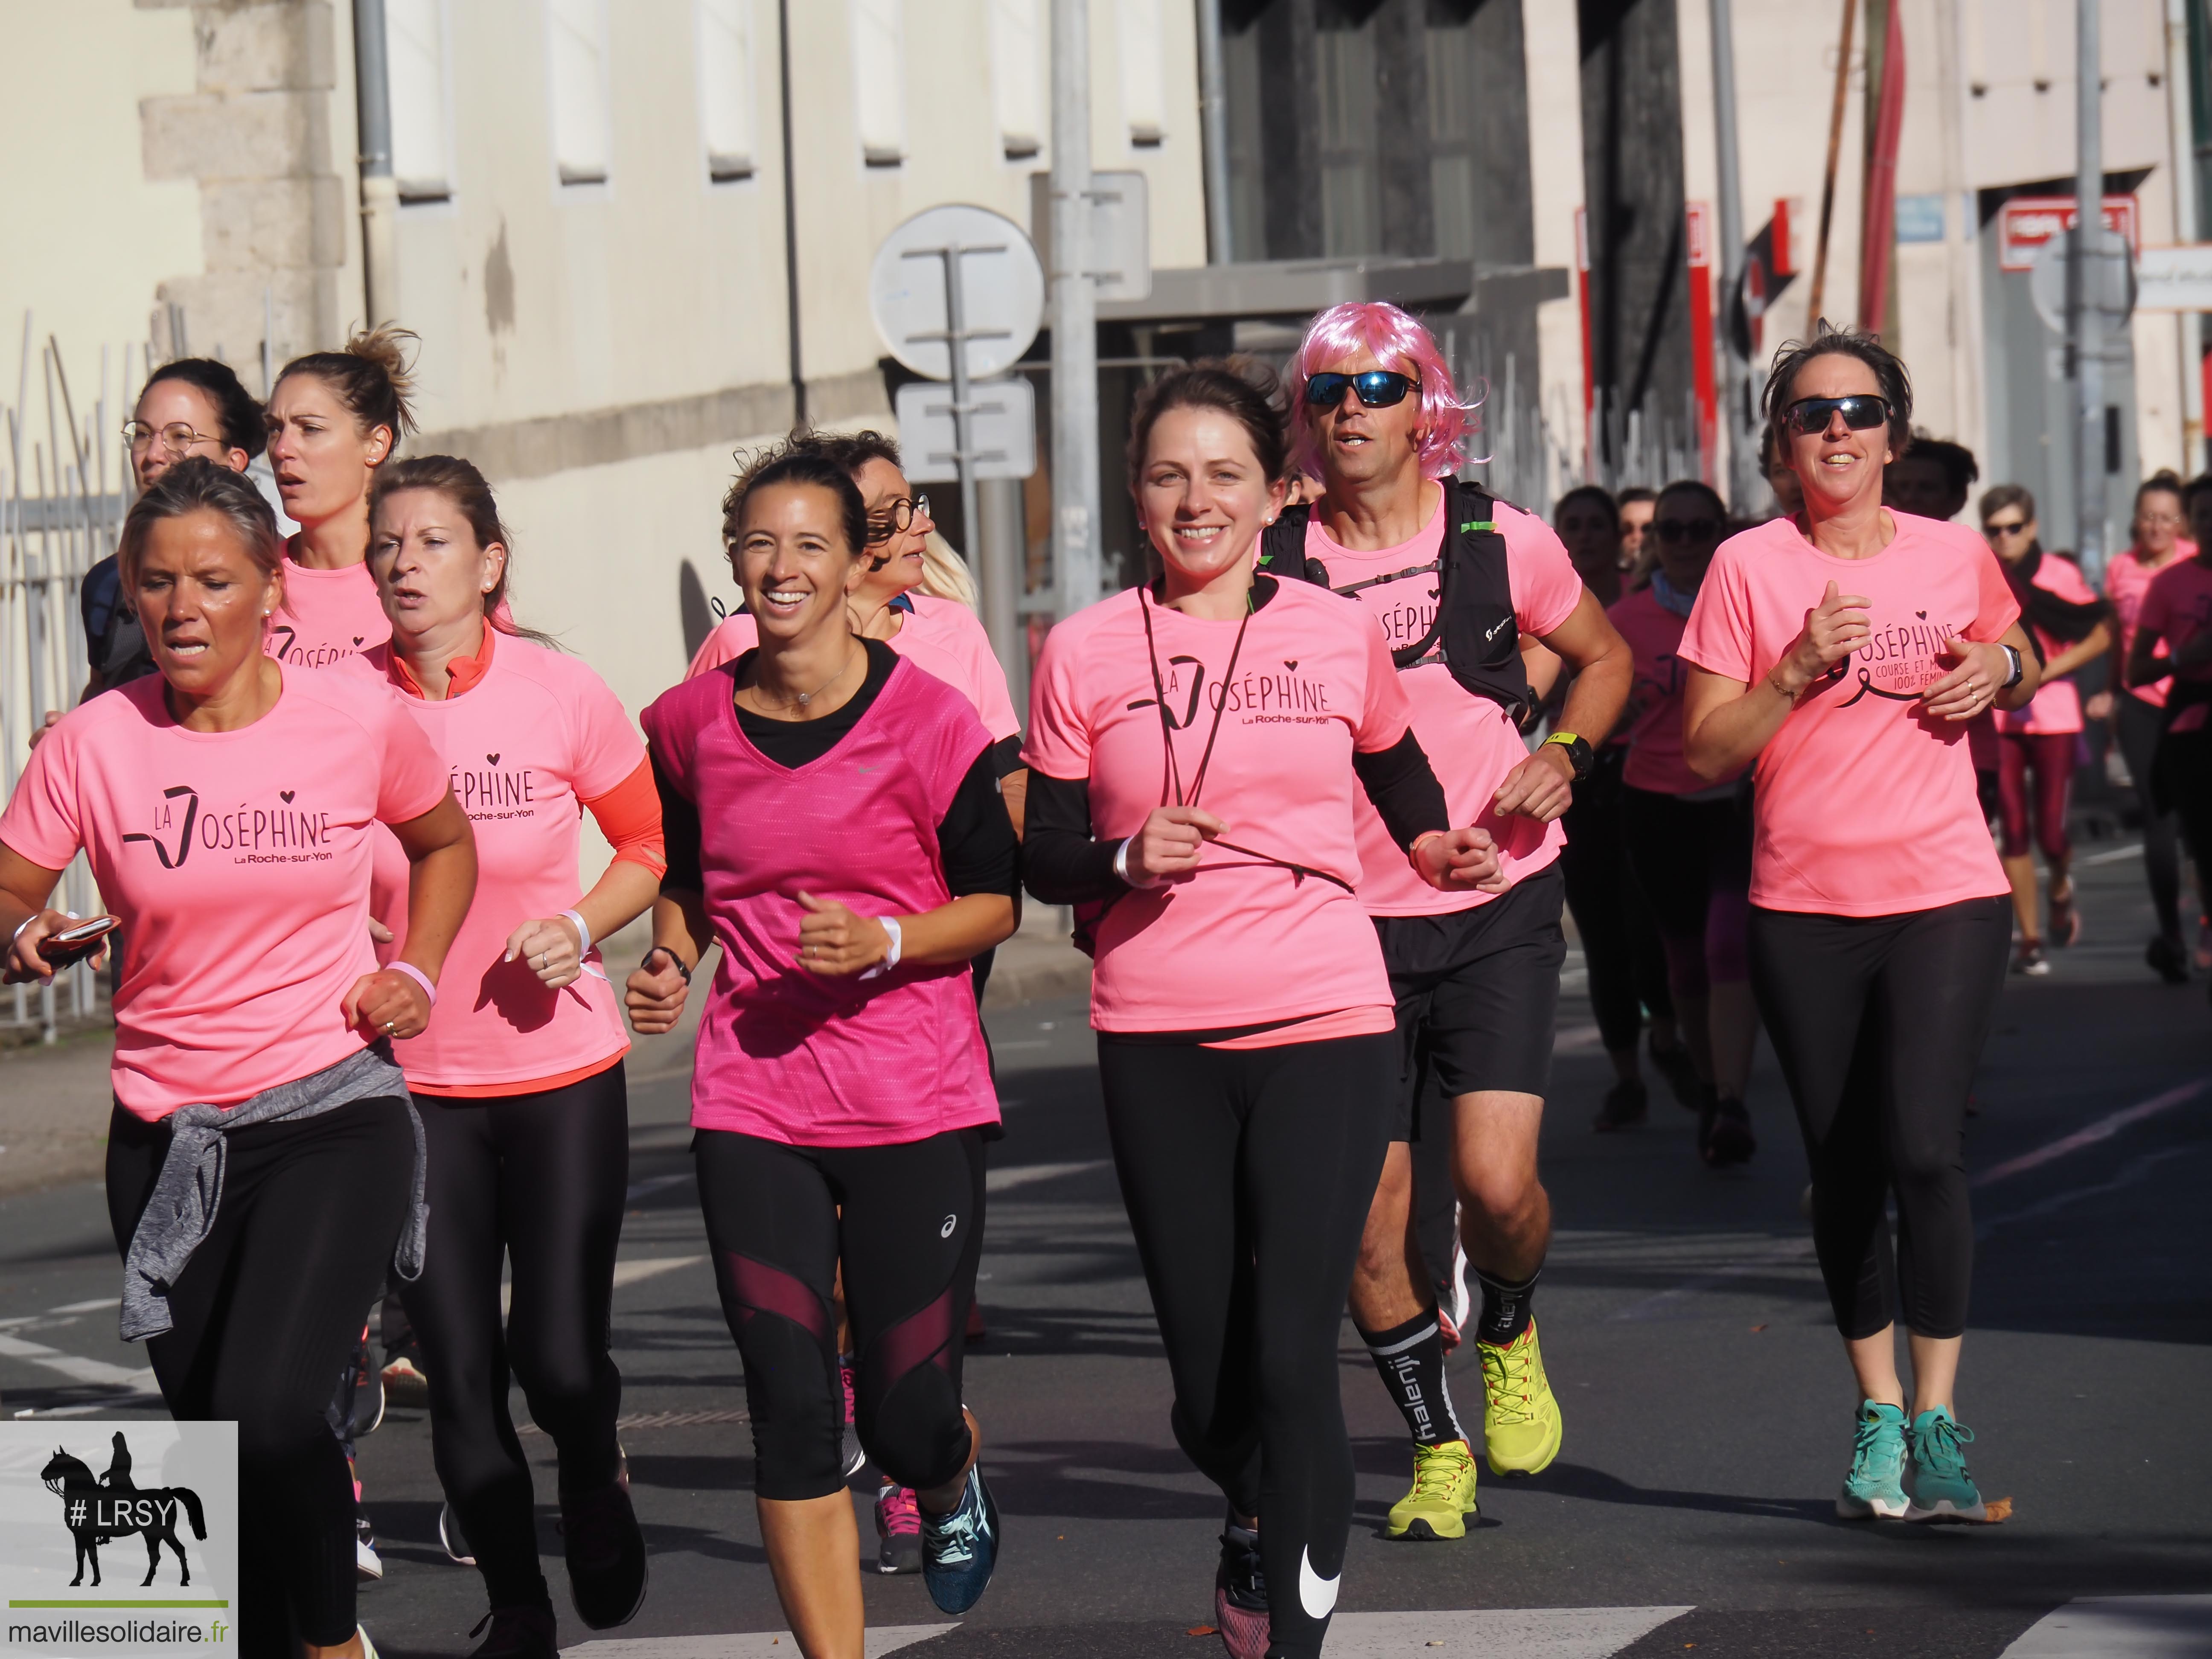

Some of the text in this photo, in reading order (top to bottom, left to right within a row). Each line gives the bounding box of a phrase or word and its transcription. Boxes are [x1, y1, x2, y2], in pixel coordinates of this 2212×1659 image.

[1876, 663, 1909, 678] COURSE
[1915, 660, 1924, 673] ET
[1255, 715, 1329, 725] Roche-sur-Yon
[155, 804, 171, 830] LA
[468, 809, 534, 821] oche-sur-Yon
[247, 852, 332, 864] Roche-sur-Yon
